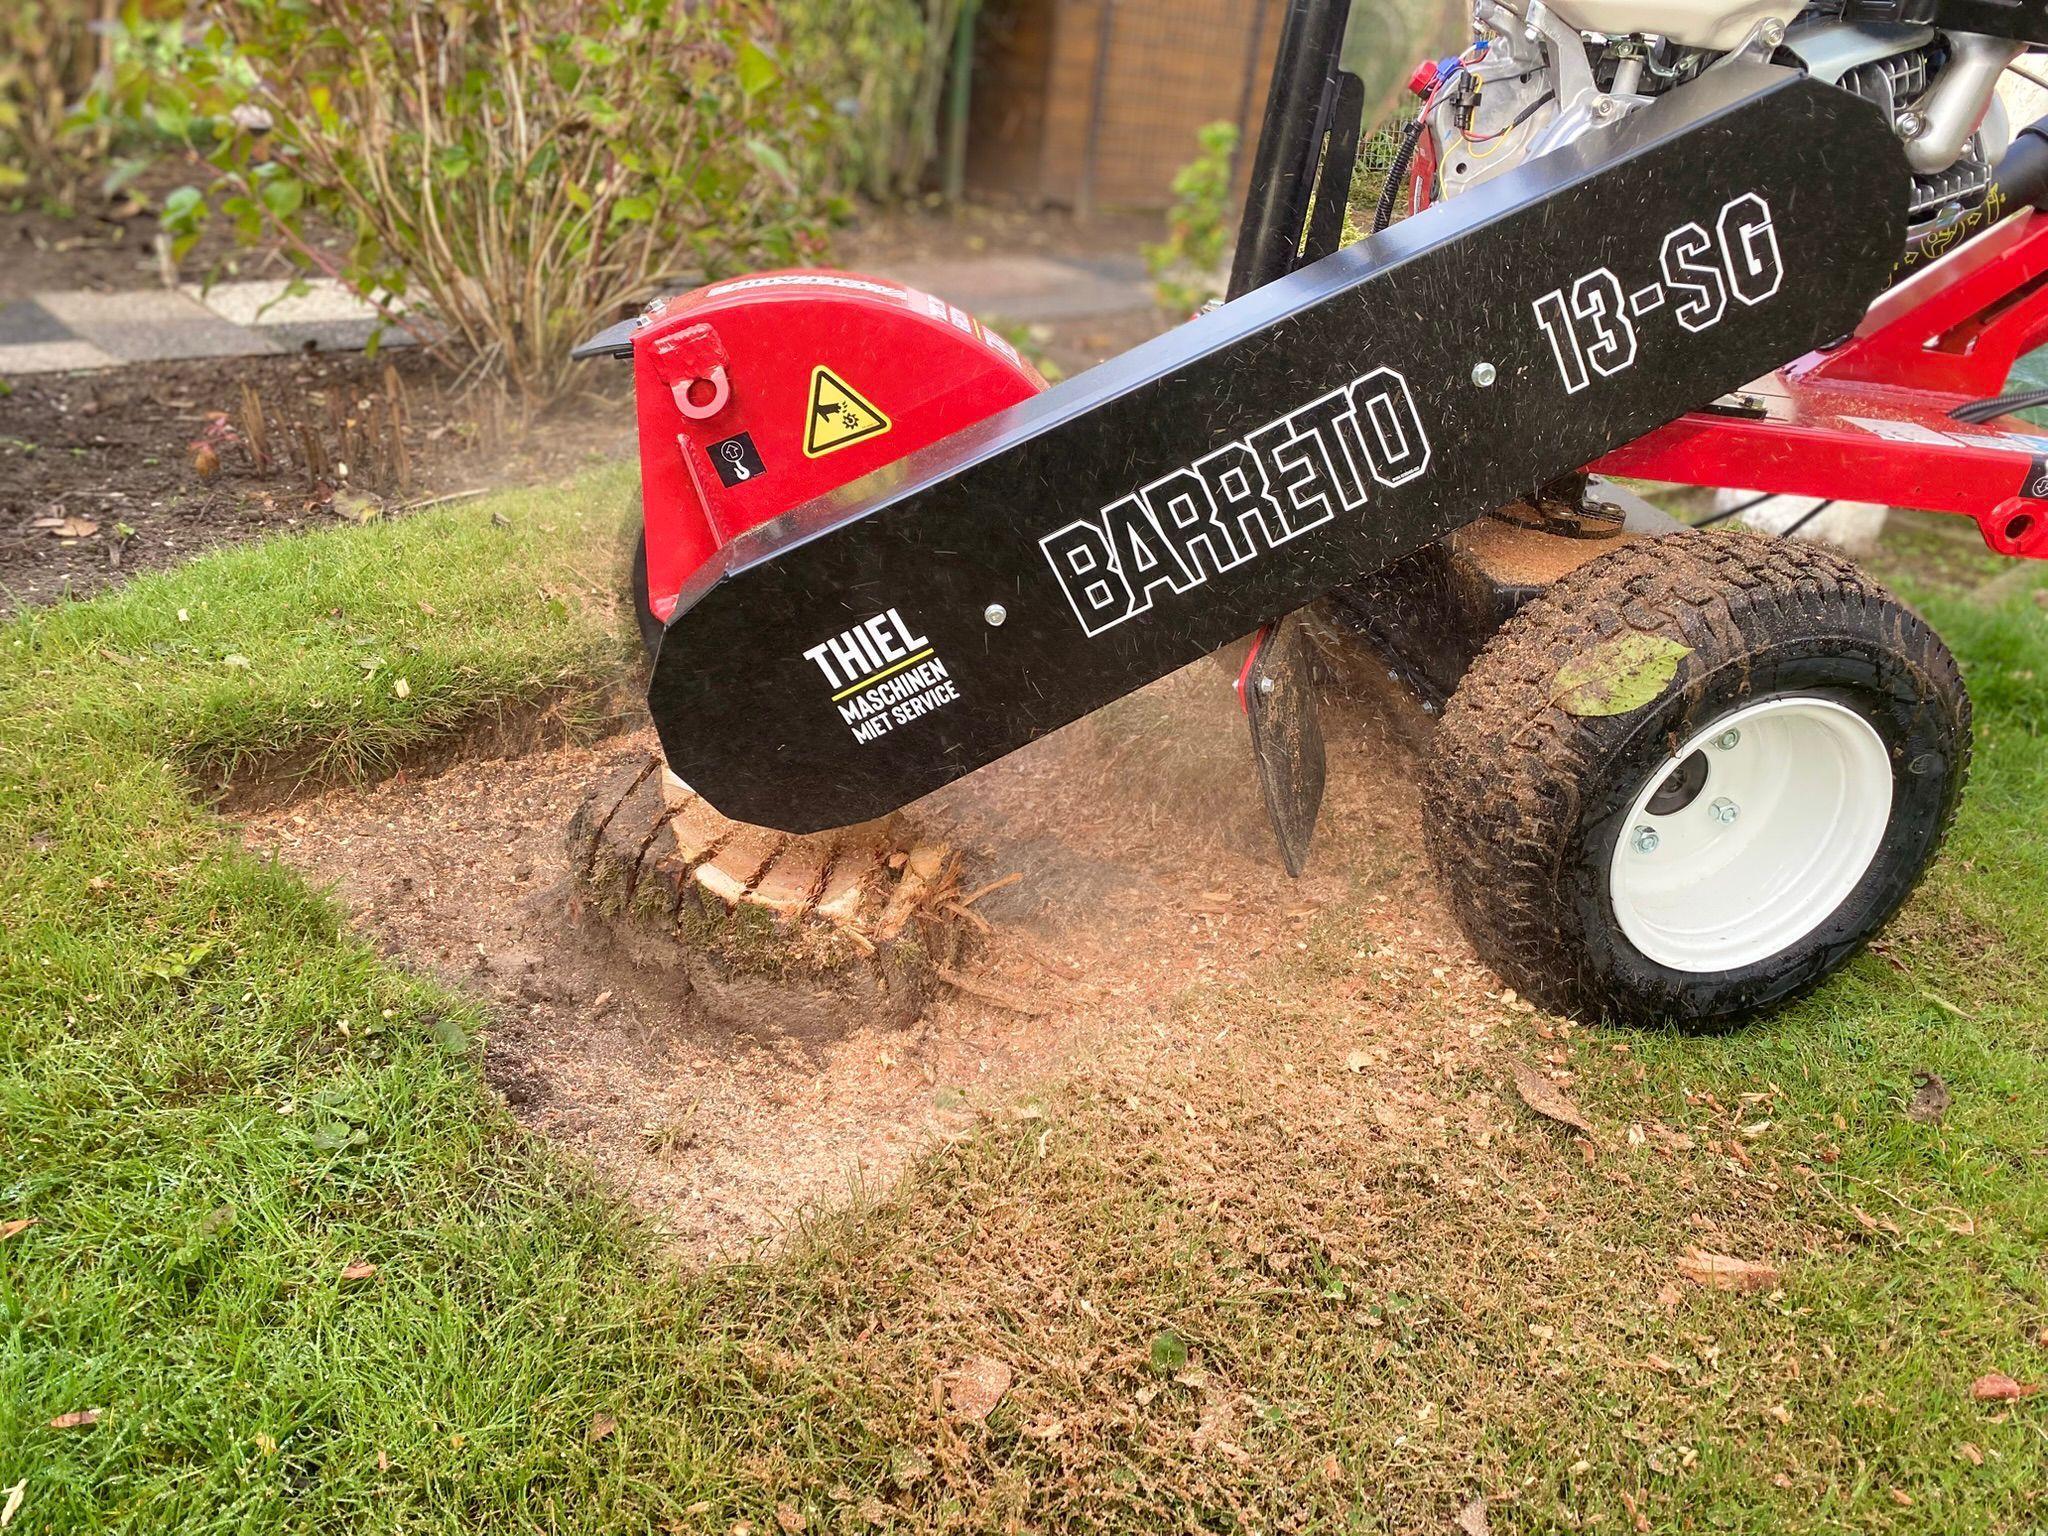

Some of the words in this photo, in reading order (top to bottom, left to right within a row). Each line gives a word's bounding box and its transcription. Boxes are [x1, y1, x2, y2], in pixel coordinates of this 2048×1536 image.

[1038, 366, 1431, 638] BARRETO
[1532, 191, 1784, 395] 13-SG
[802, 607, 930, 690] THIEL
[836, 656, 950, 726] MASCHINEN
[850, 711, 895, 746] MIET
[891, 679, 962, 726] SERVICE
